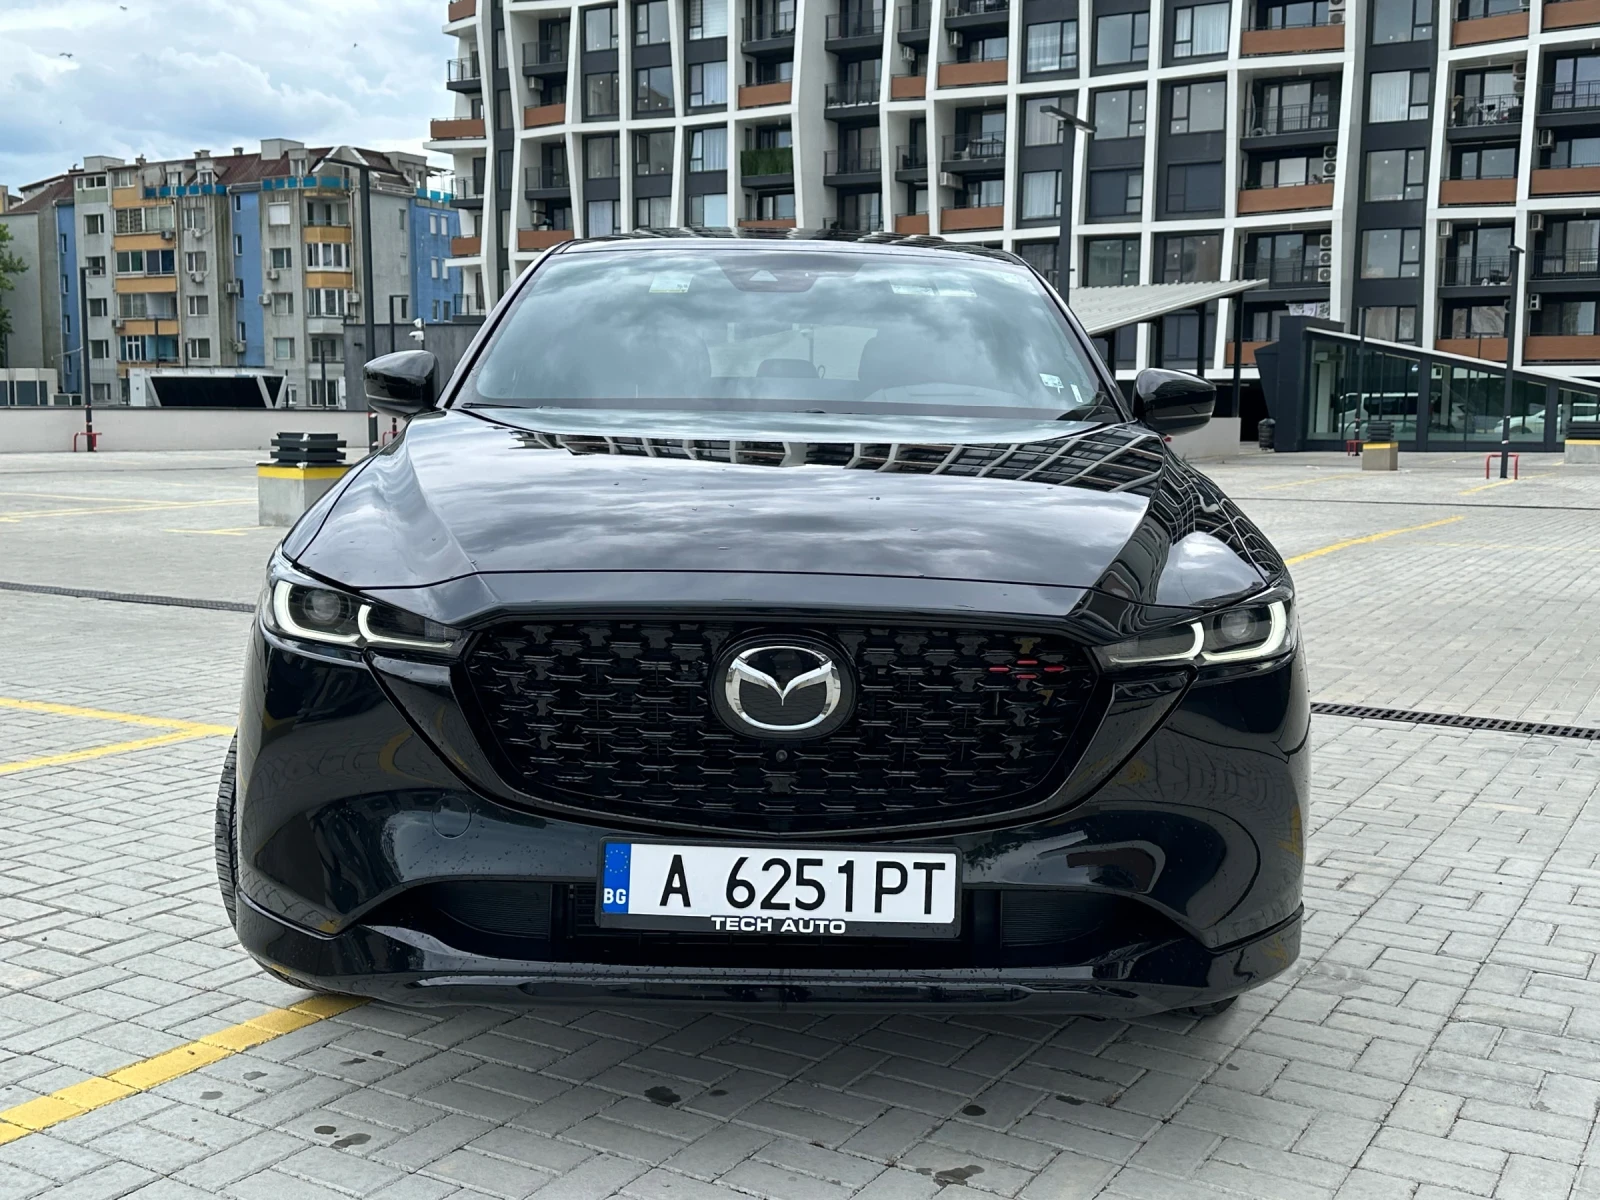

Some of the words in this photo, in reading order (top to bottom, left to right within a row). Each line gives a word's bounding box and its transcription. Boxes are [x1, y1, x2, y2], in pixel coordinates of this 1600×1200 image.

[659, 854, 691, 907] A
[603, 888, 627, 905] BG
[711, 916, 773, 932] TECH
[780, 919, 847, 934] AUTO
